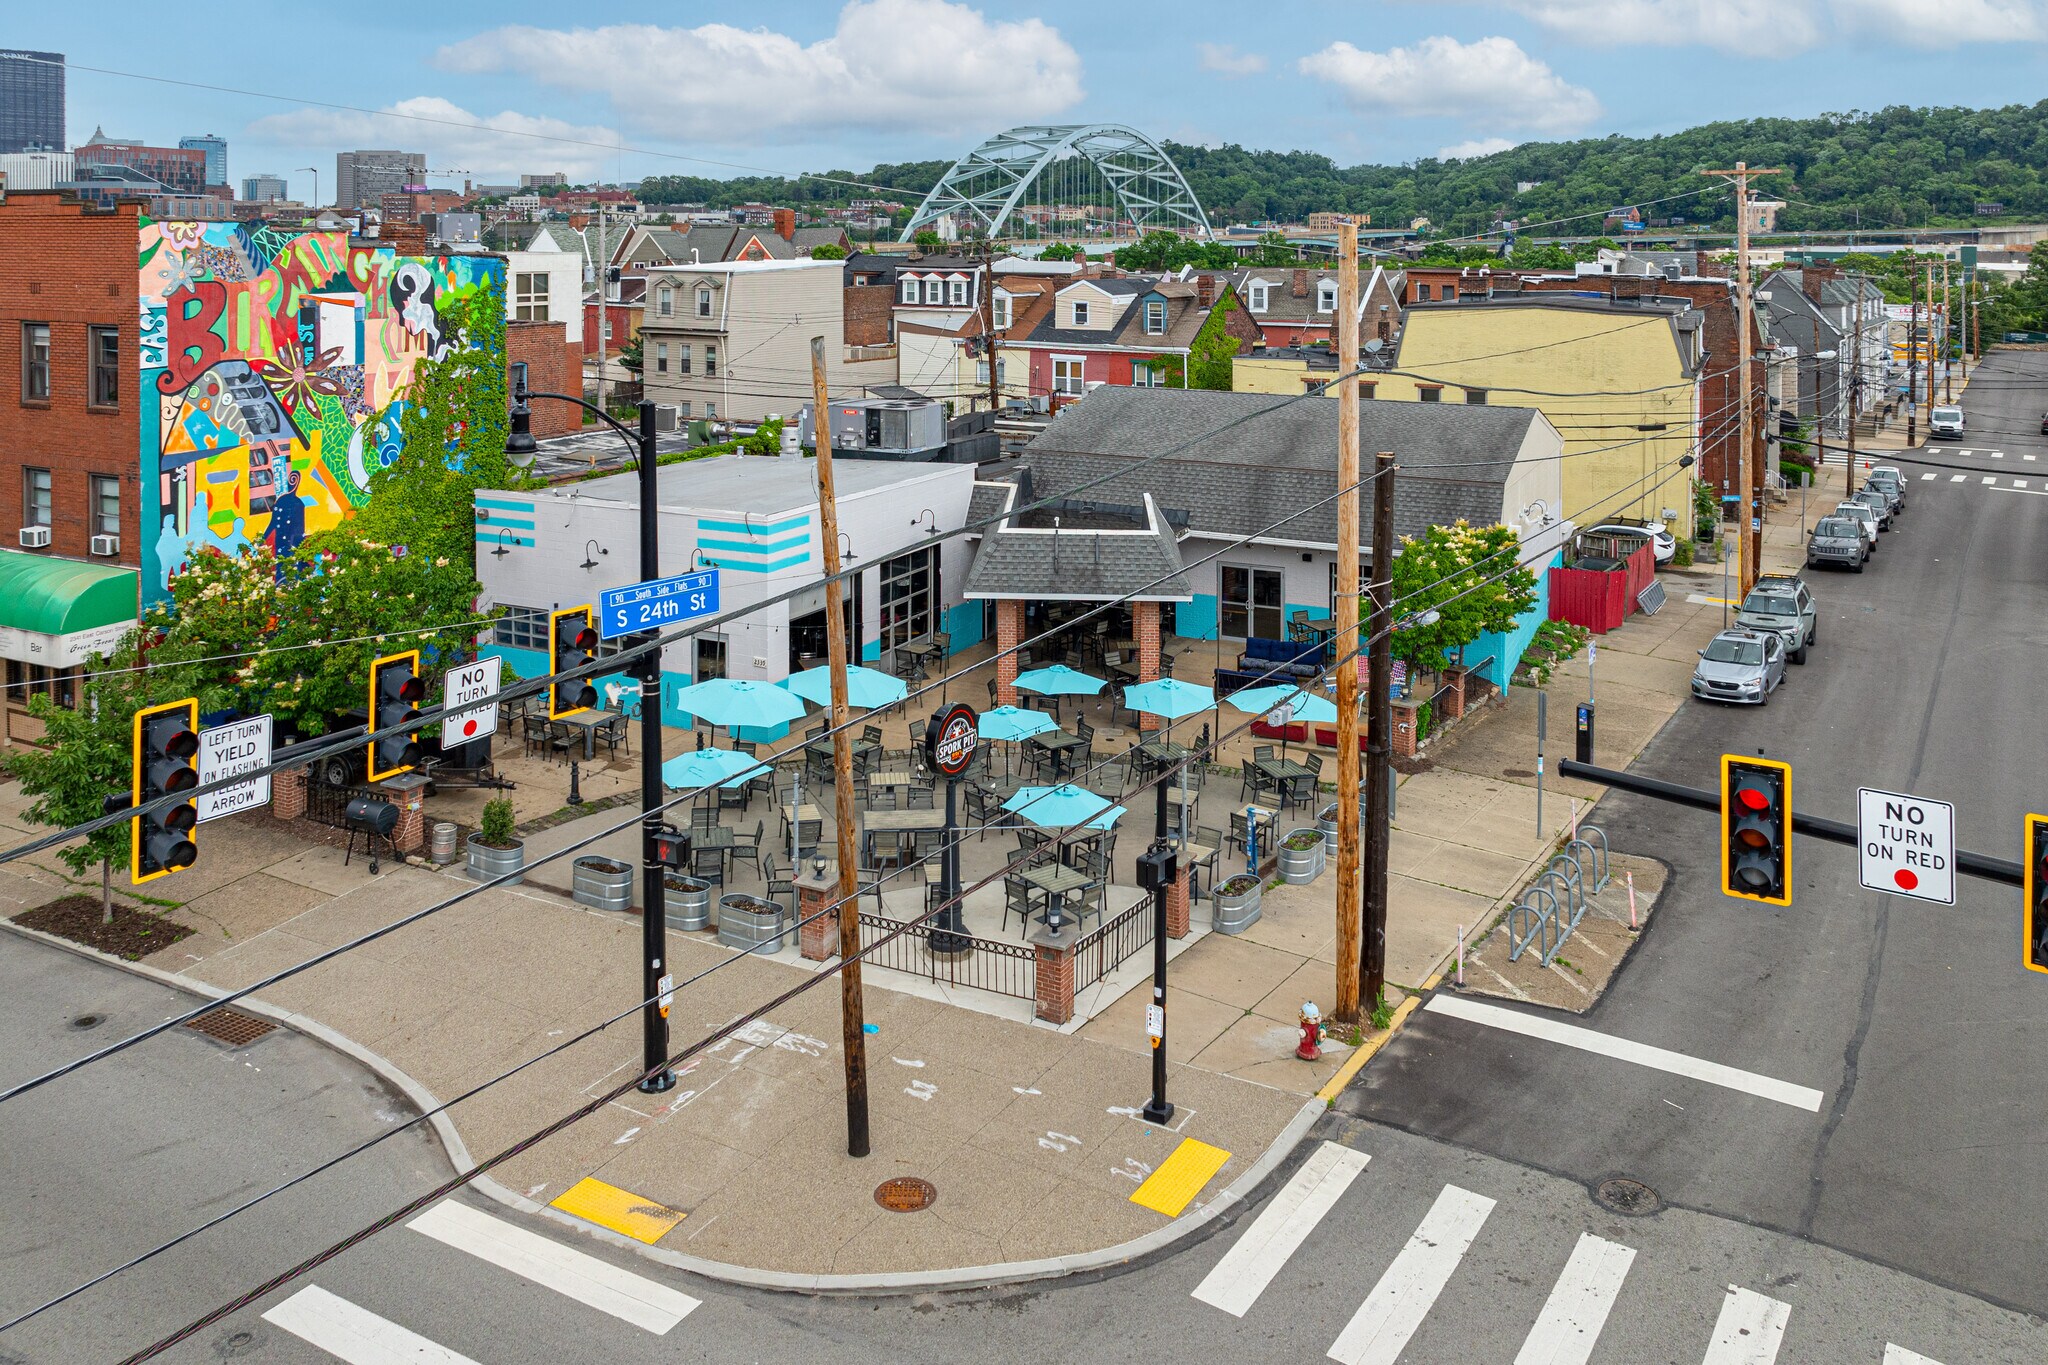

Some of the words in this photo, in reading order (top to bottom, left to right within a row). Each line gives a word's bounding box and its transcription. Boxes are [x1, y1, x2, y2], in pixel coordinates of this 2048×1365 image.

[615, 594, 624, 603] 90
[635, 590, 652, 600] South
[656, 585, 670, 595] Side
[674, 581, 688, 592] Flats
[698, 577, 707, 587] 90
[616, 609, 628, 628] S
[639, 599, 679, 623] 24th
[690, 592, 706, 611] St
[30, 642, 43, 653] Bar
[462, 668, 485, 688] NO
[457, 684, 488, 704] TURN
[209, 730, 233, 747] LEFT
[237, 722, 262, 740] TURN
[940, 739, 962, 759] SPORK
[963, 733, 975, 748] PIT
[215, 741, 256, 764] YIELD
[204, 770, 217, 784] ON
[221, 757, 264, 780] FLASHING
[210, 789, 255, 813] ARROW
[1886, 801, 1925, 825] NO
[1878, 824, 1933, 848] TURN
[1867, 842, 1893, 861] ON
[1906, 849, 1945, 870] RED
